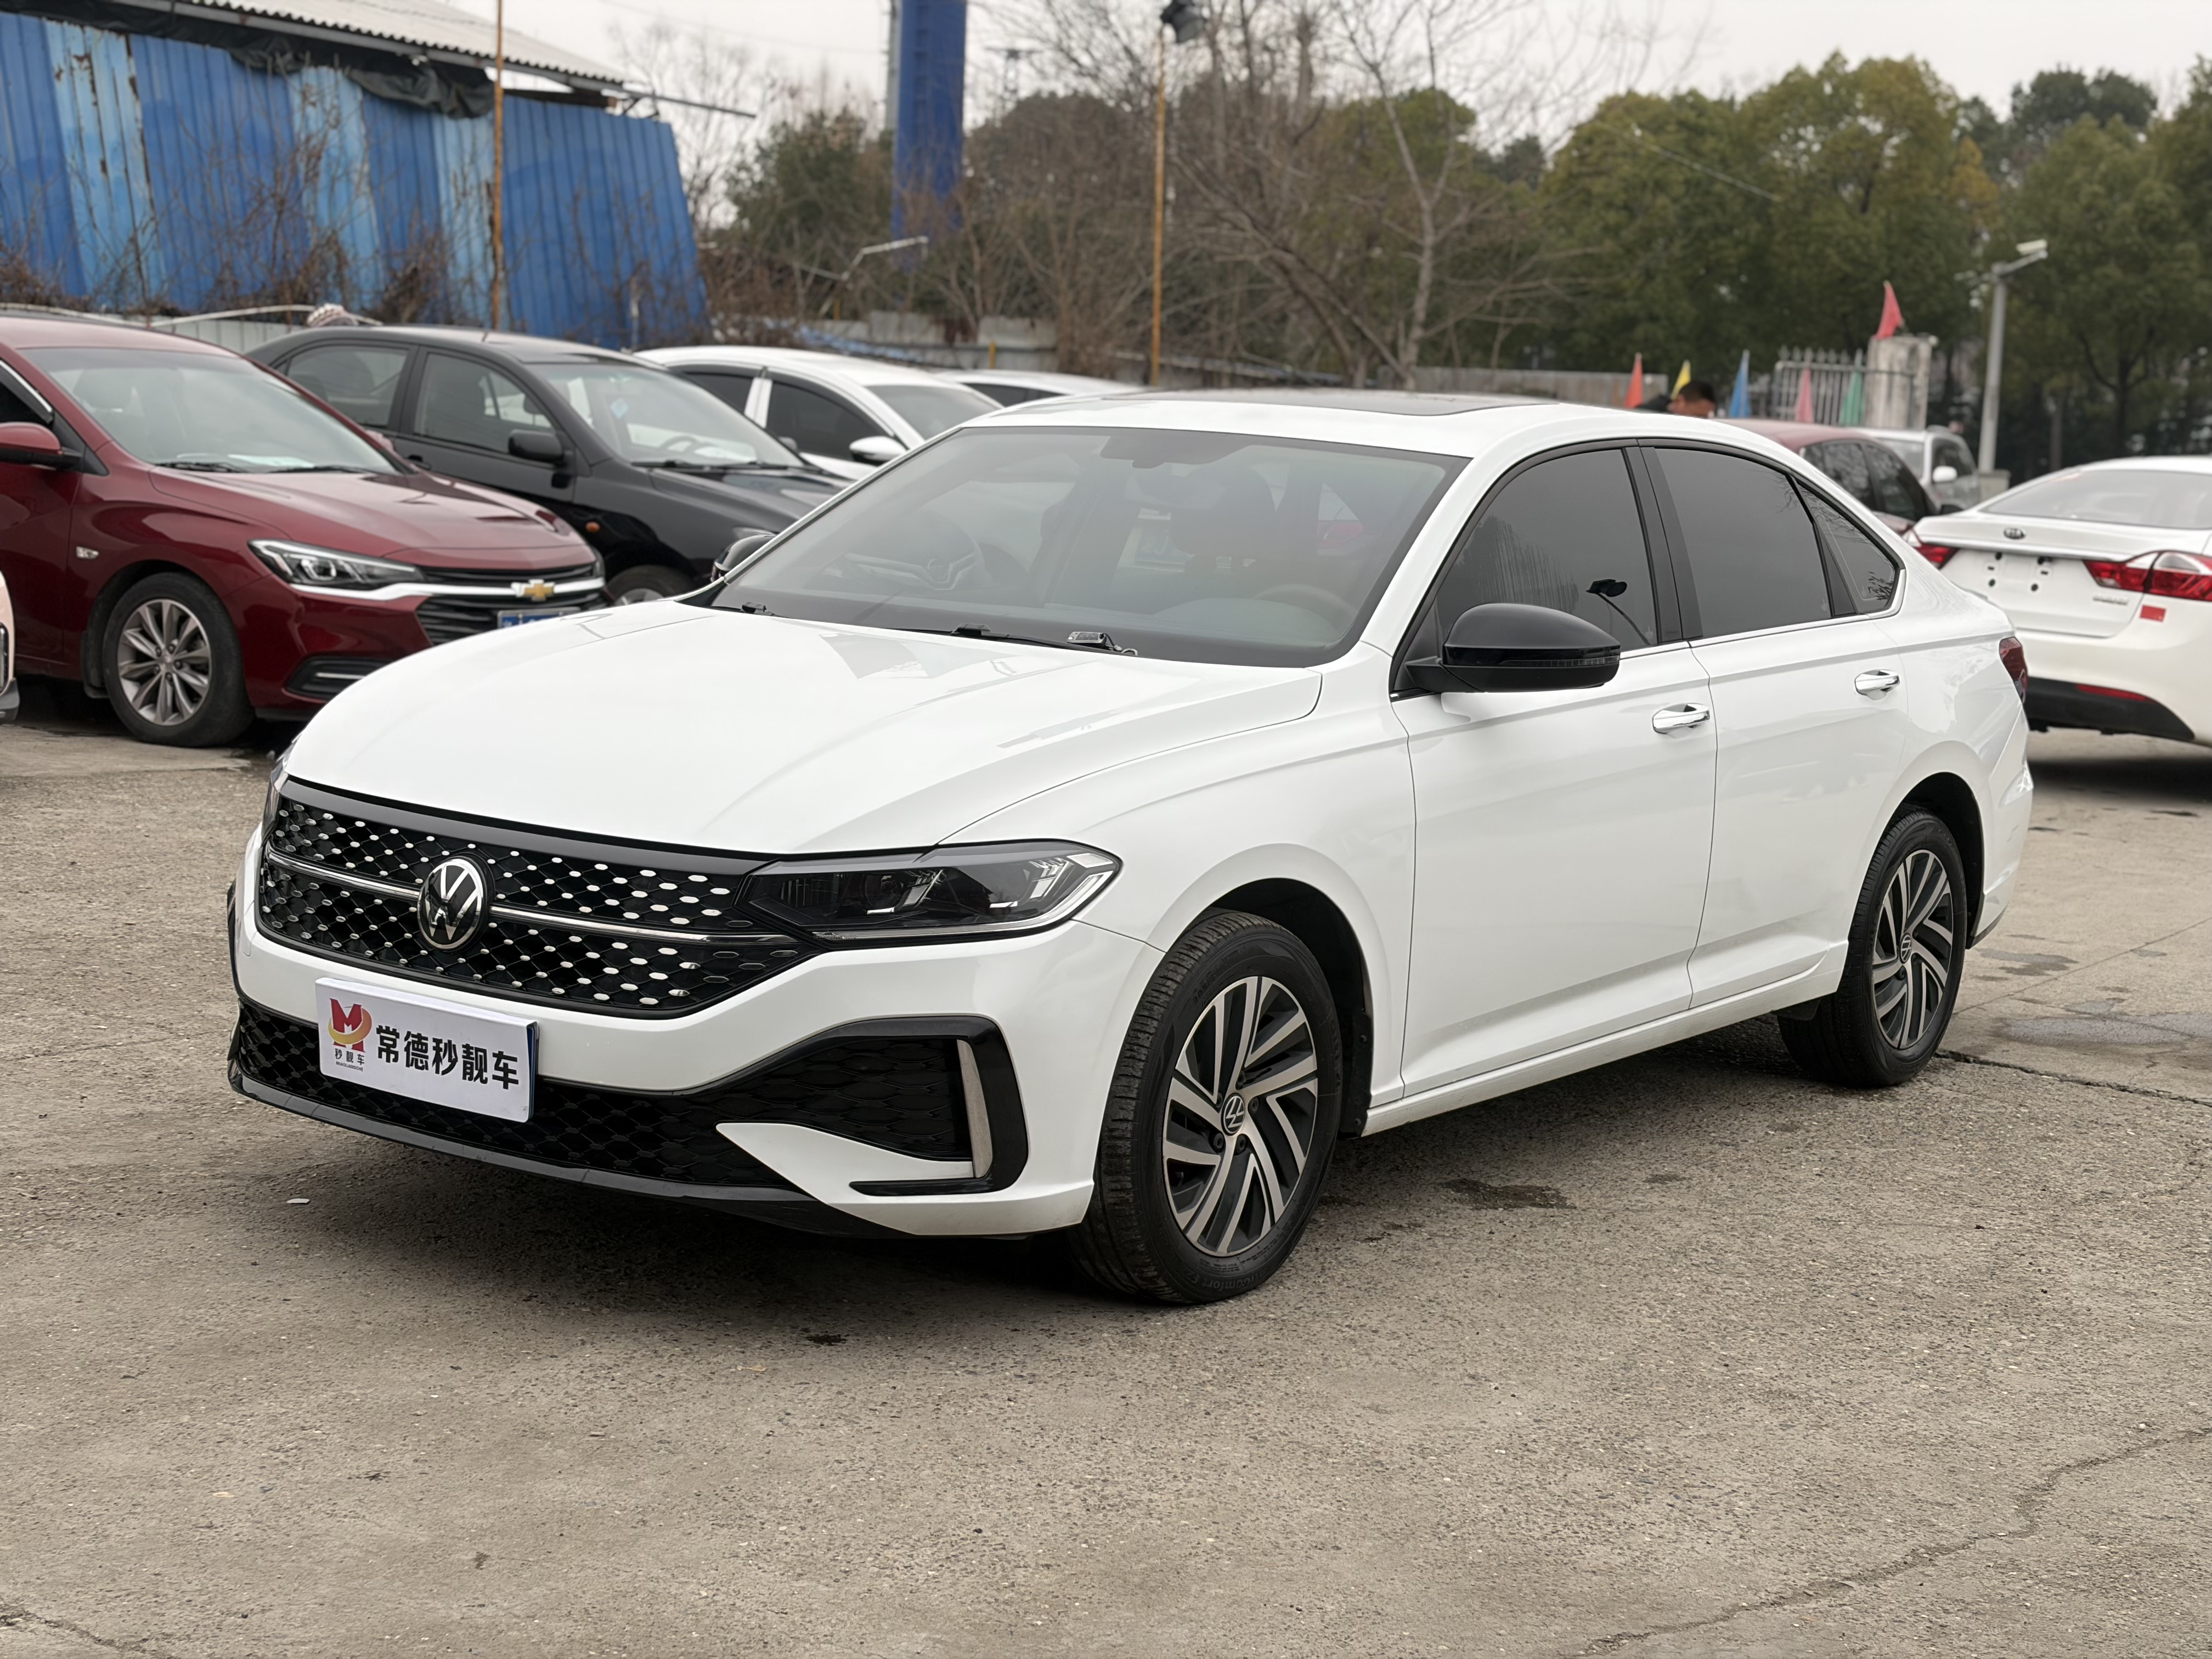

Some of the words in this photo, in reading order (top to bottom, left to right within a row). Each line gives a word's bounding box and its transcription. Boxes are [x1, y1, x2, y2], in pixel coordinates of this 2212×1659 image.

[335, 1048, 365, 1065] 秒靓车
[376, 1025, 519, 1090] 常德秒靓车
